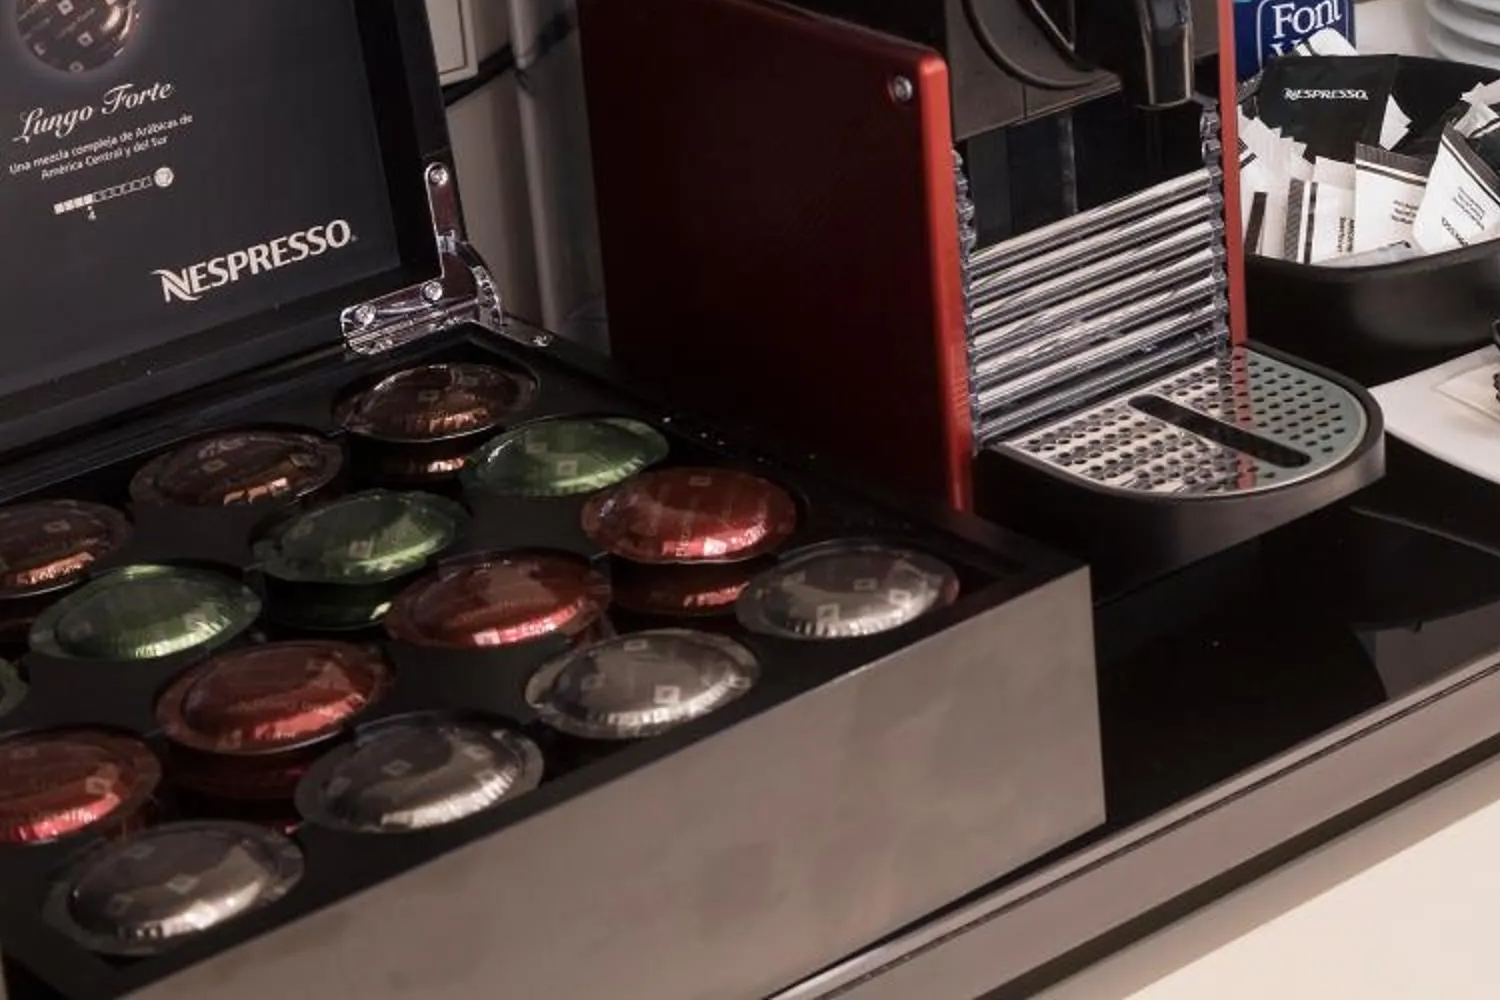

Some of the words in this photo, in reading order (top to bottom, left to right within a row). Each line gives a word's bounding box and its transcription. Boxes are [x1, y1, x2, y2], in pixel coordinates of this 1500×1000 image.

[12, 106, 94, 144] Lungo
[101, 82, 175, 116] Forte
[1283, 86, 1367, 102] NESPRESSO
[9, 162, 32, 175] Una
[119, 130, 135, 144] de
[179, 112, 194, 126] de
[133, 138, 151, 154] del
[152, 134, 169, 148] Sur
[150, 219, 352, 304] NESPRESSO
